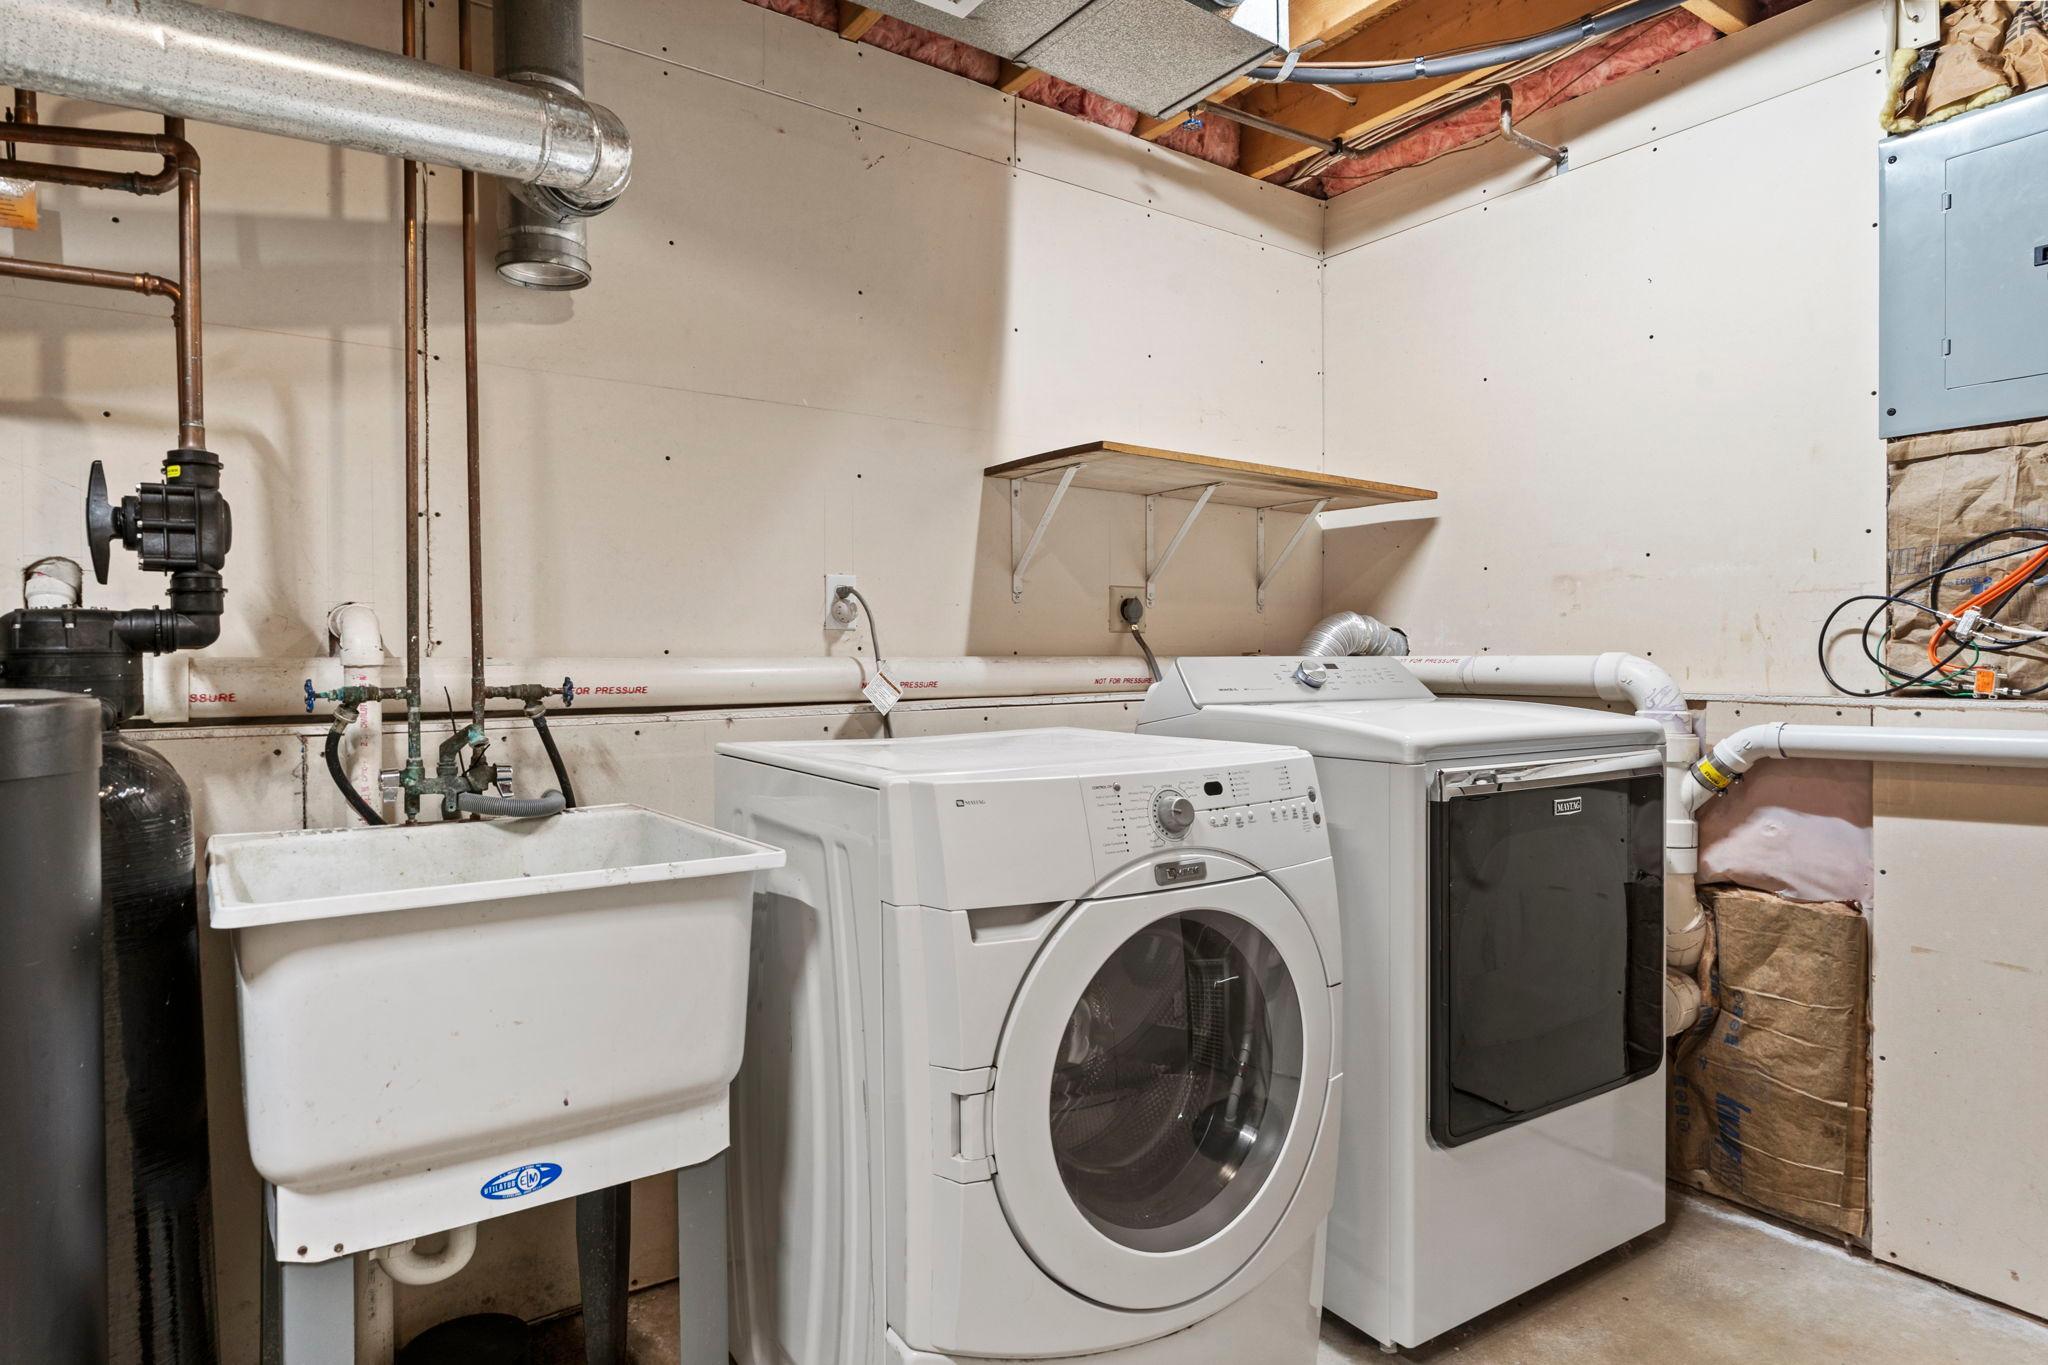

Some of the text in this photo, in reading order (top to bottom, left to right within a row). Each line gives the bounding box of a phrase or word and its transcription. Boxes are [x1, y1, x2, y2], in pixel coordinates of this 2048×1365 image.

[900, 681, 938, 689] PRESSURE
[1108, 677, 1121, 685] FOR
[594, 686, 648, 695] PRESSURE
[189, 693, 237, 703] SSURE
[1557, 801, 1580, 812] MAYTAG
[483, 1179, 517, 1195] UTILATUB
